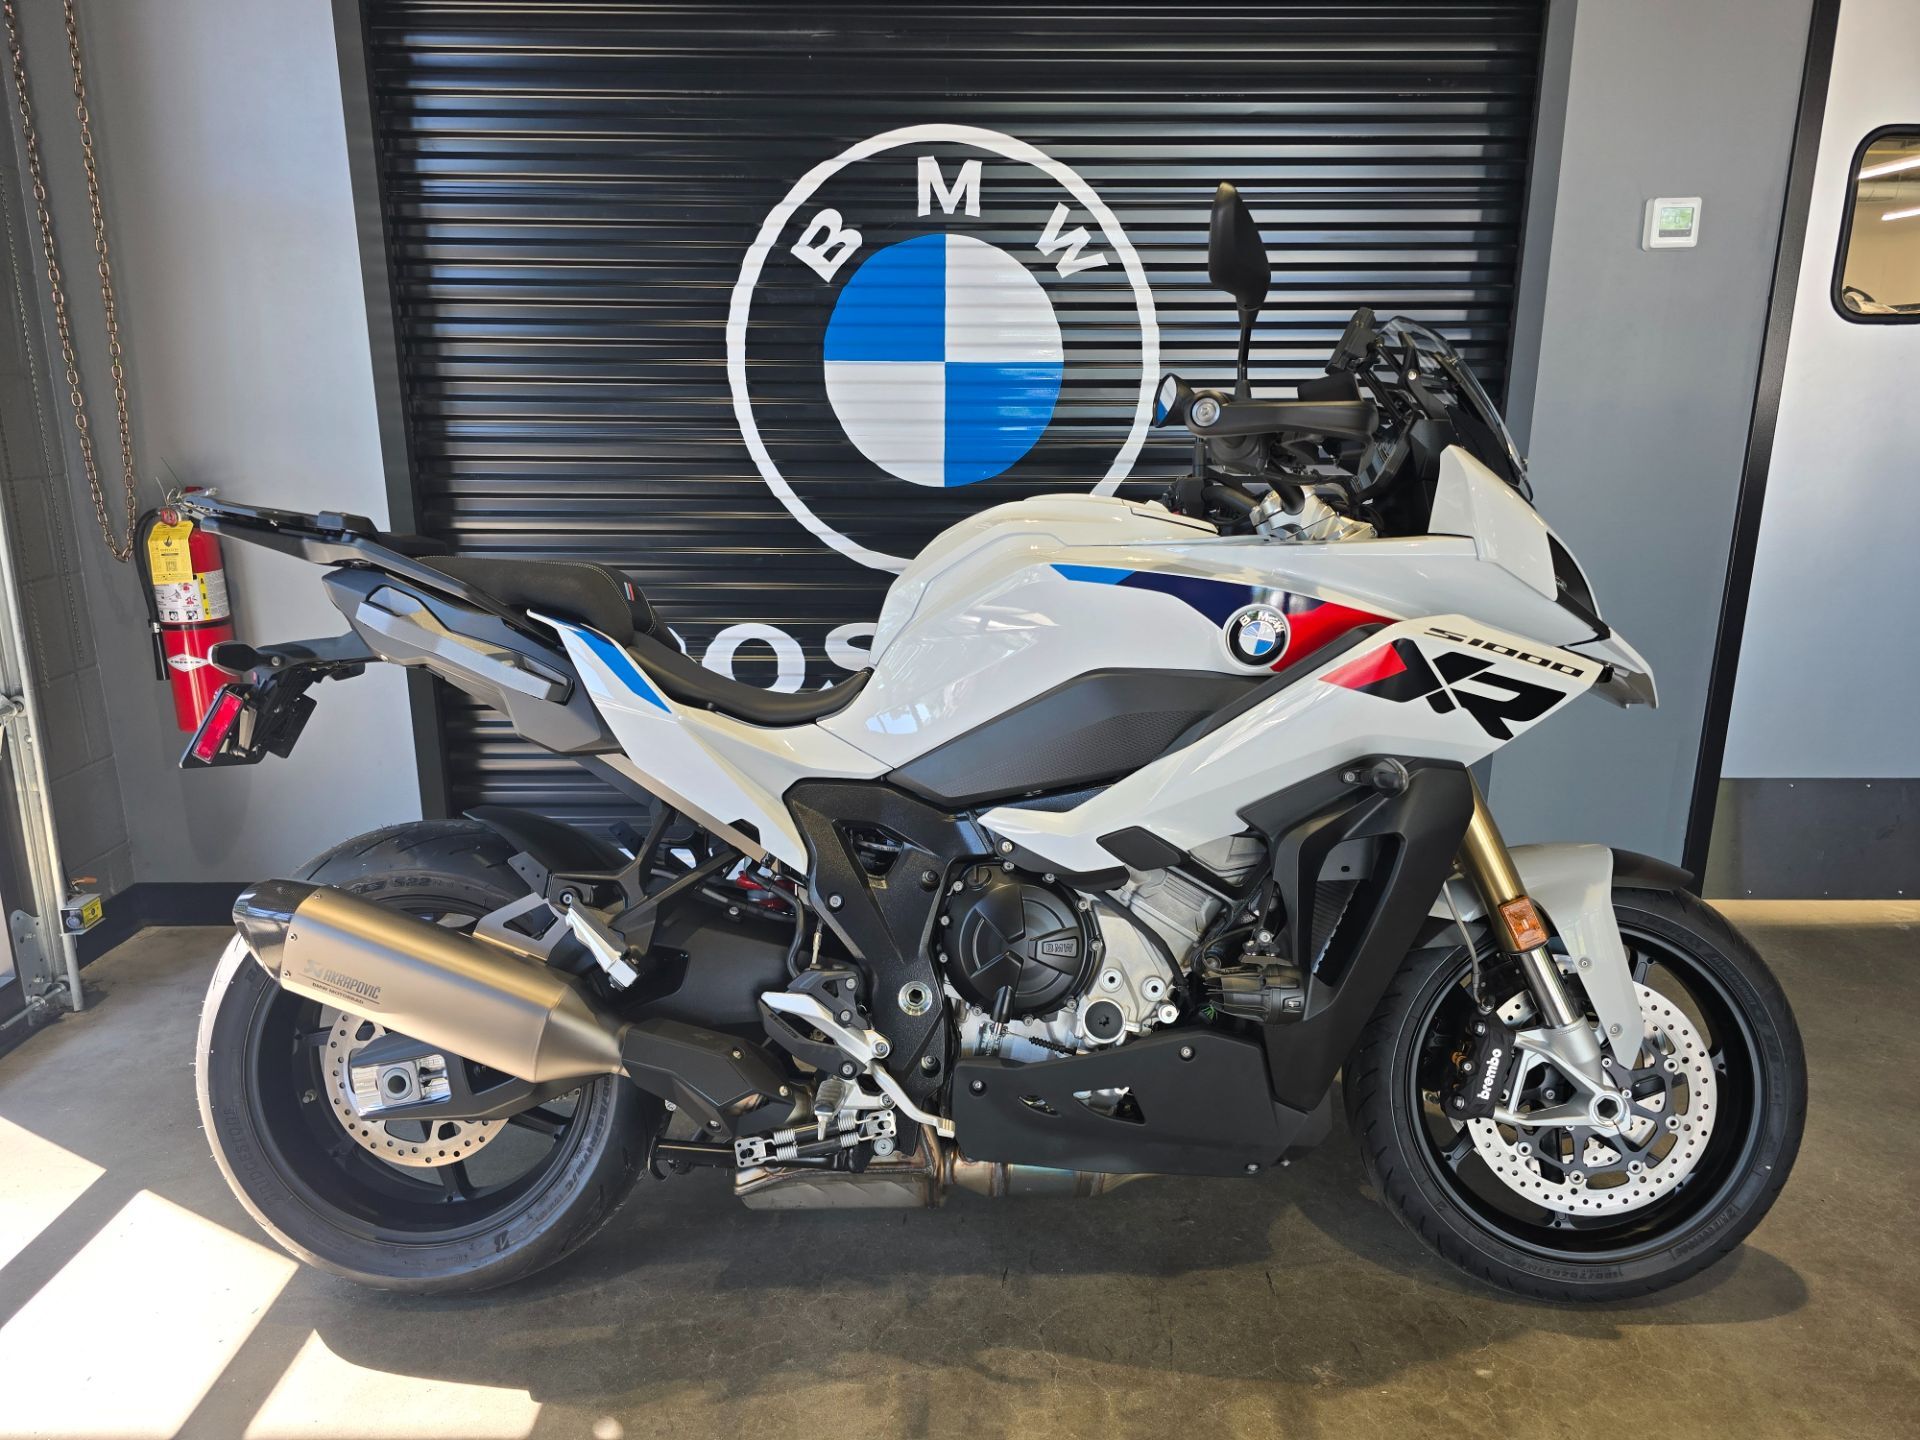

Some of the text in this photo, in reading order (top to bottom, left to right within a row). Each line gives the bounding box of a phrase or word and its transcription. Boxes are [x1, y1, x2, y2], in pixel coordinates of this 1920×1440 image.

[791, 155, 1108, 283] BMW
[1239, 611, 1287, 633] BMW
[1424, 627, 1584, 678] S1000
[1352, 638, 1567, 741] XR
[1045, 943, 1074, 953] BMW
[1476, 1048, 1502, 1101] brembo
